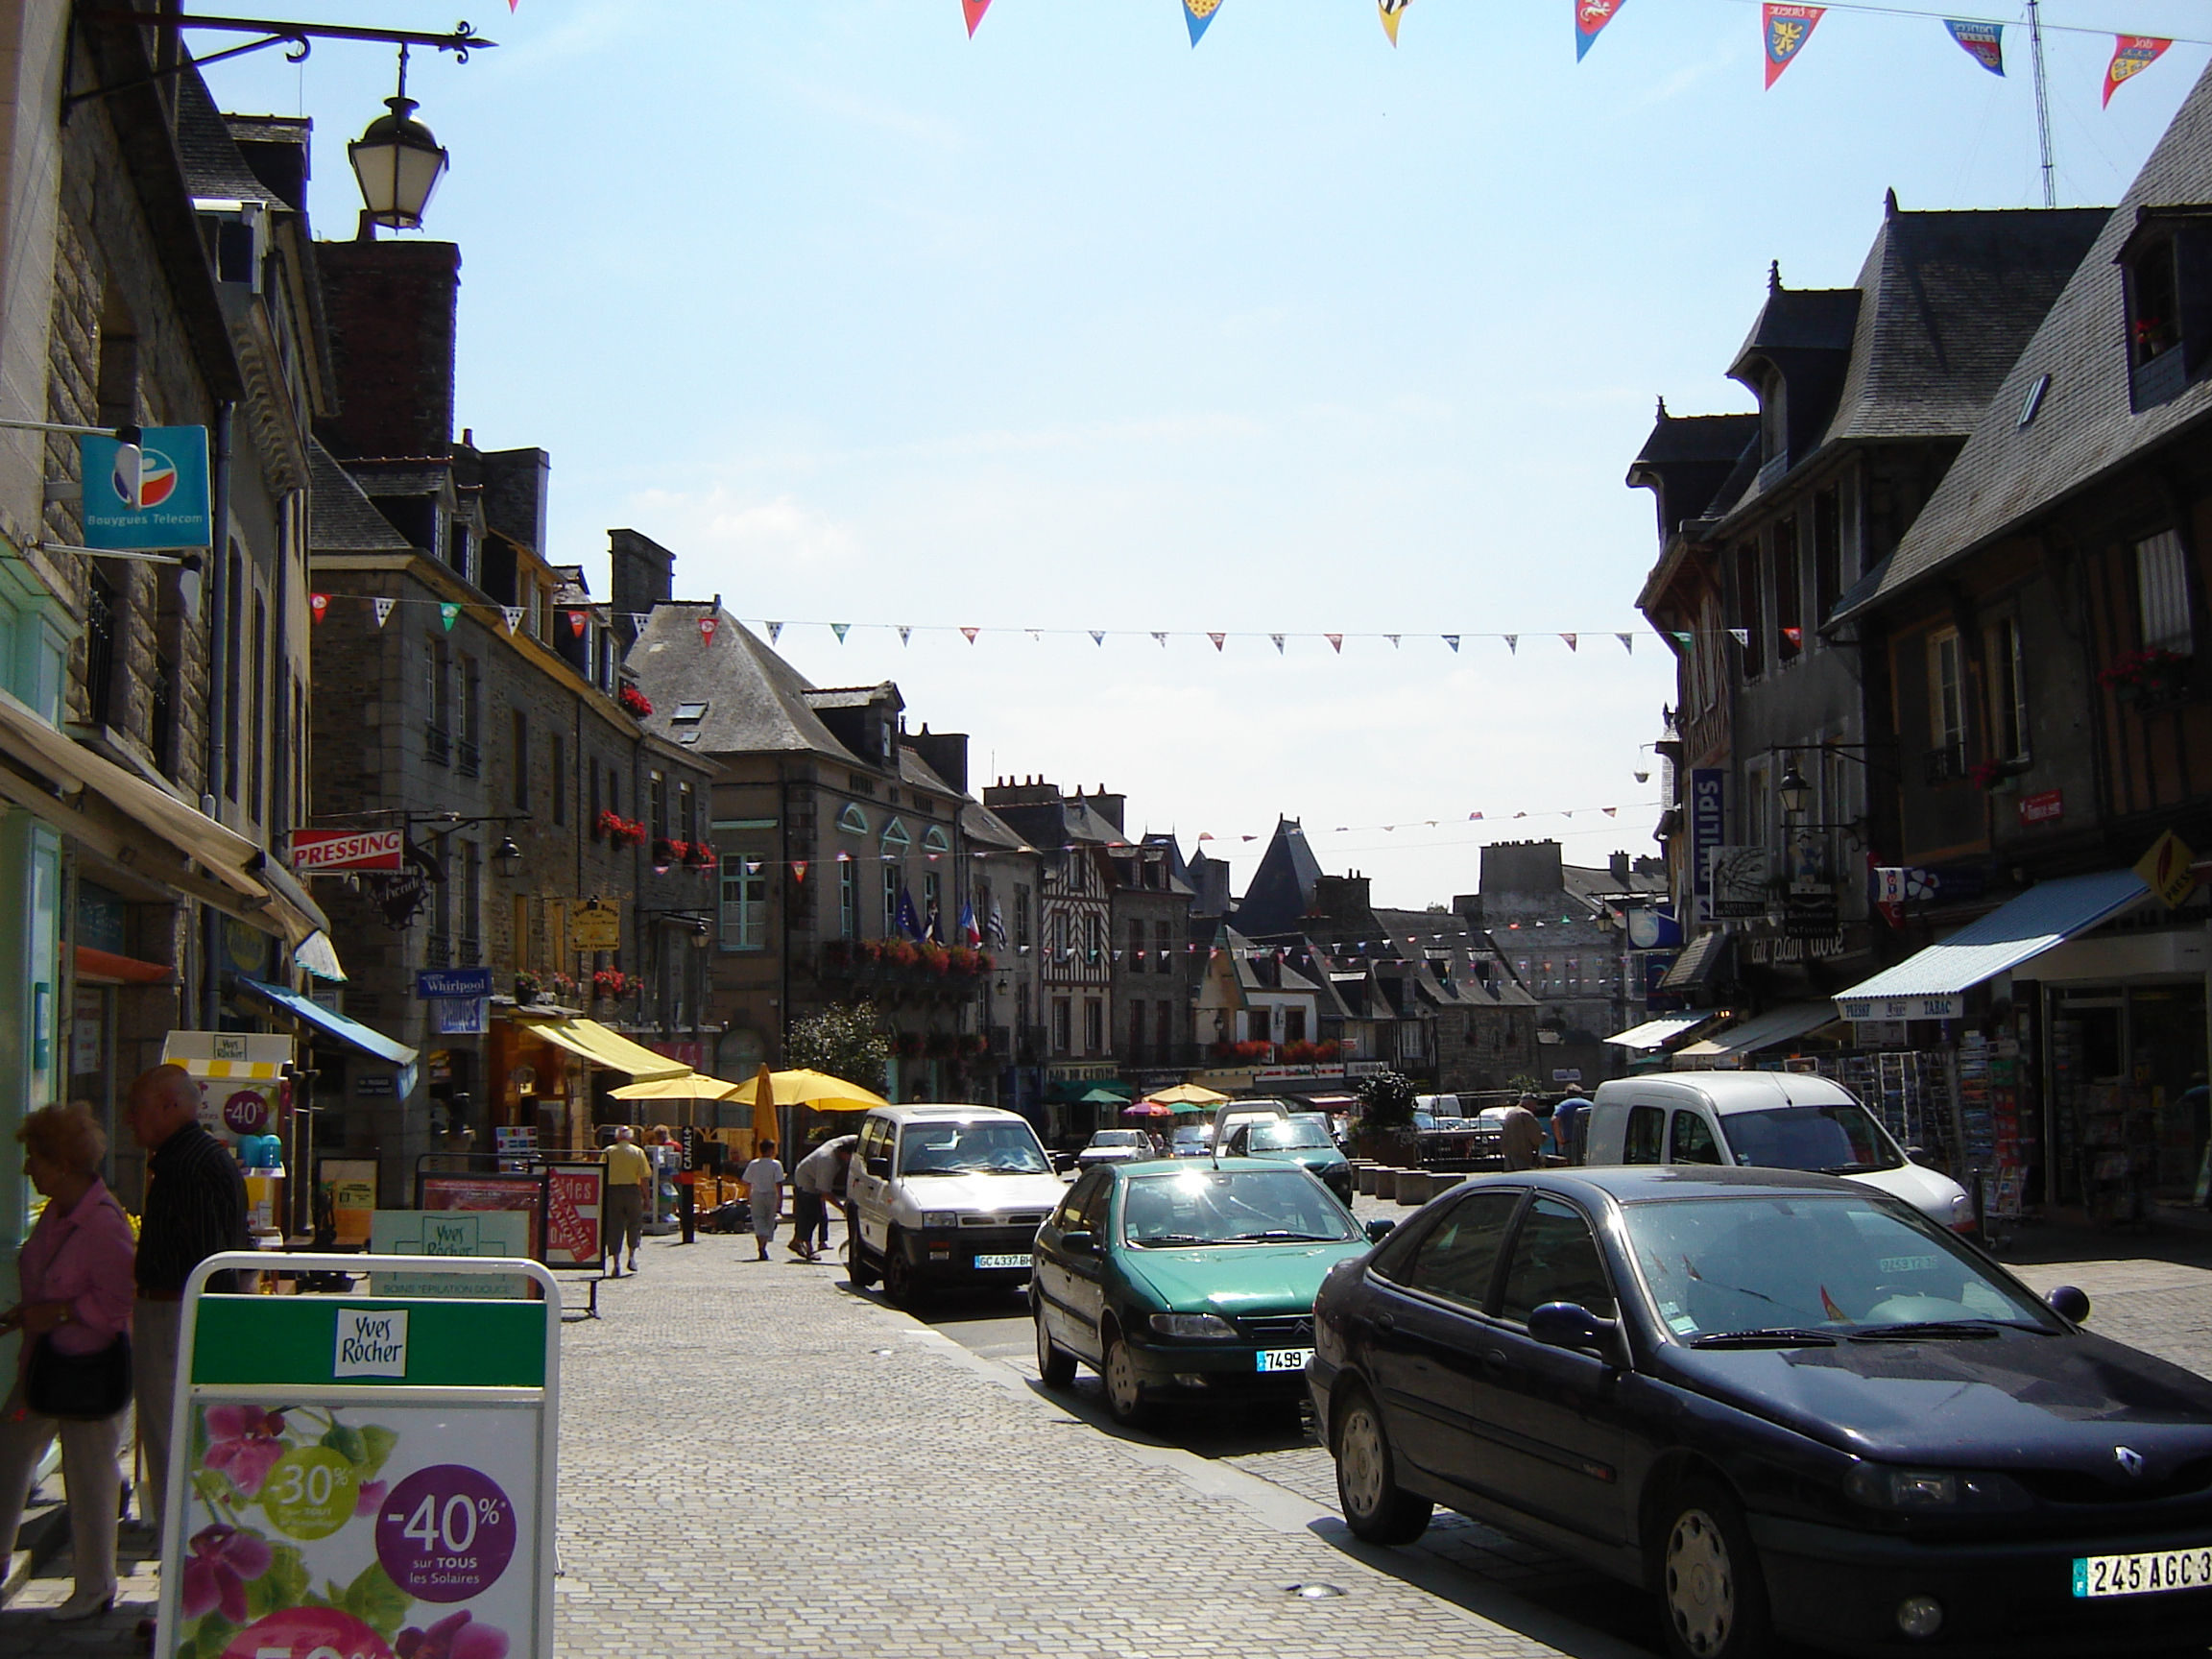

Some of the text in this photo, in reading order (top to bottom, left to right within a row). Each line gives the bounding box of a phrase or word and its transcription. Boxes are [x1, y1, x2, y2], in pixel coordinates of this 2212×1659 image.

[87, 513, 203, 527] Bouygues Telecom
[293, 830, 400, 868] PRESSING
[2164, 867, 2195, 902] PRESS
[1773, 936, 1805, 968] pain
[427, 977, 485, 994] Whirlpool
[1923, 999, 1952, 1016] TABAC
[683, 1127, 693, 1170] CANAL+
[436, 1224, 466, 1247] Yves
[994, 1255, 1019, 1266] 4337
[383, 1284, 415, 1294] SOINS
[355, 1316, 392, 1344] Yves
[342, 1337, 403, 1364] Rocher
[1265, 1351, 1302, 1369] 7499
[413, 1557, 478, 1569] sur TOUS
[2094, 1558, 2141, 1593] 245
[2150, 1553, 2192, 1588] AGC
[409, 1573, 480, 1584] les Solaires
